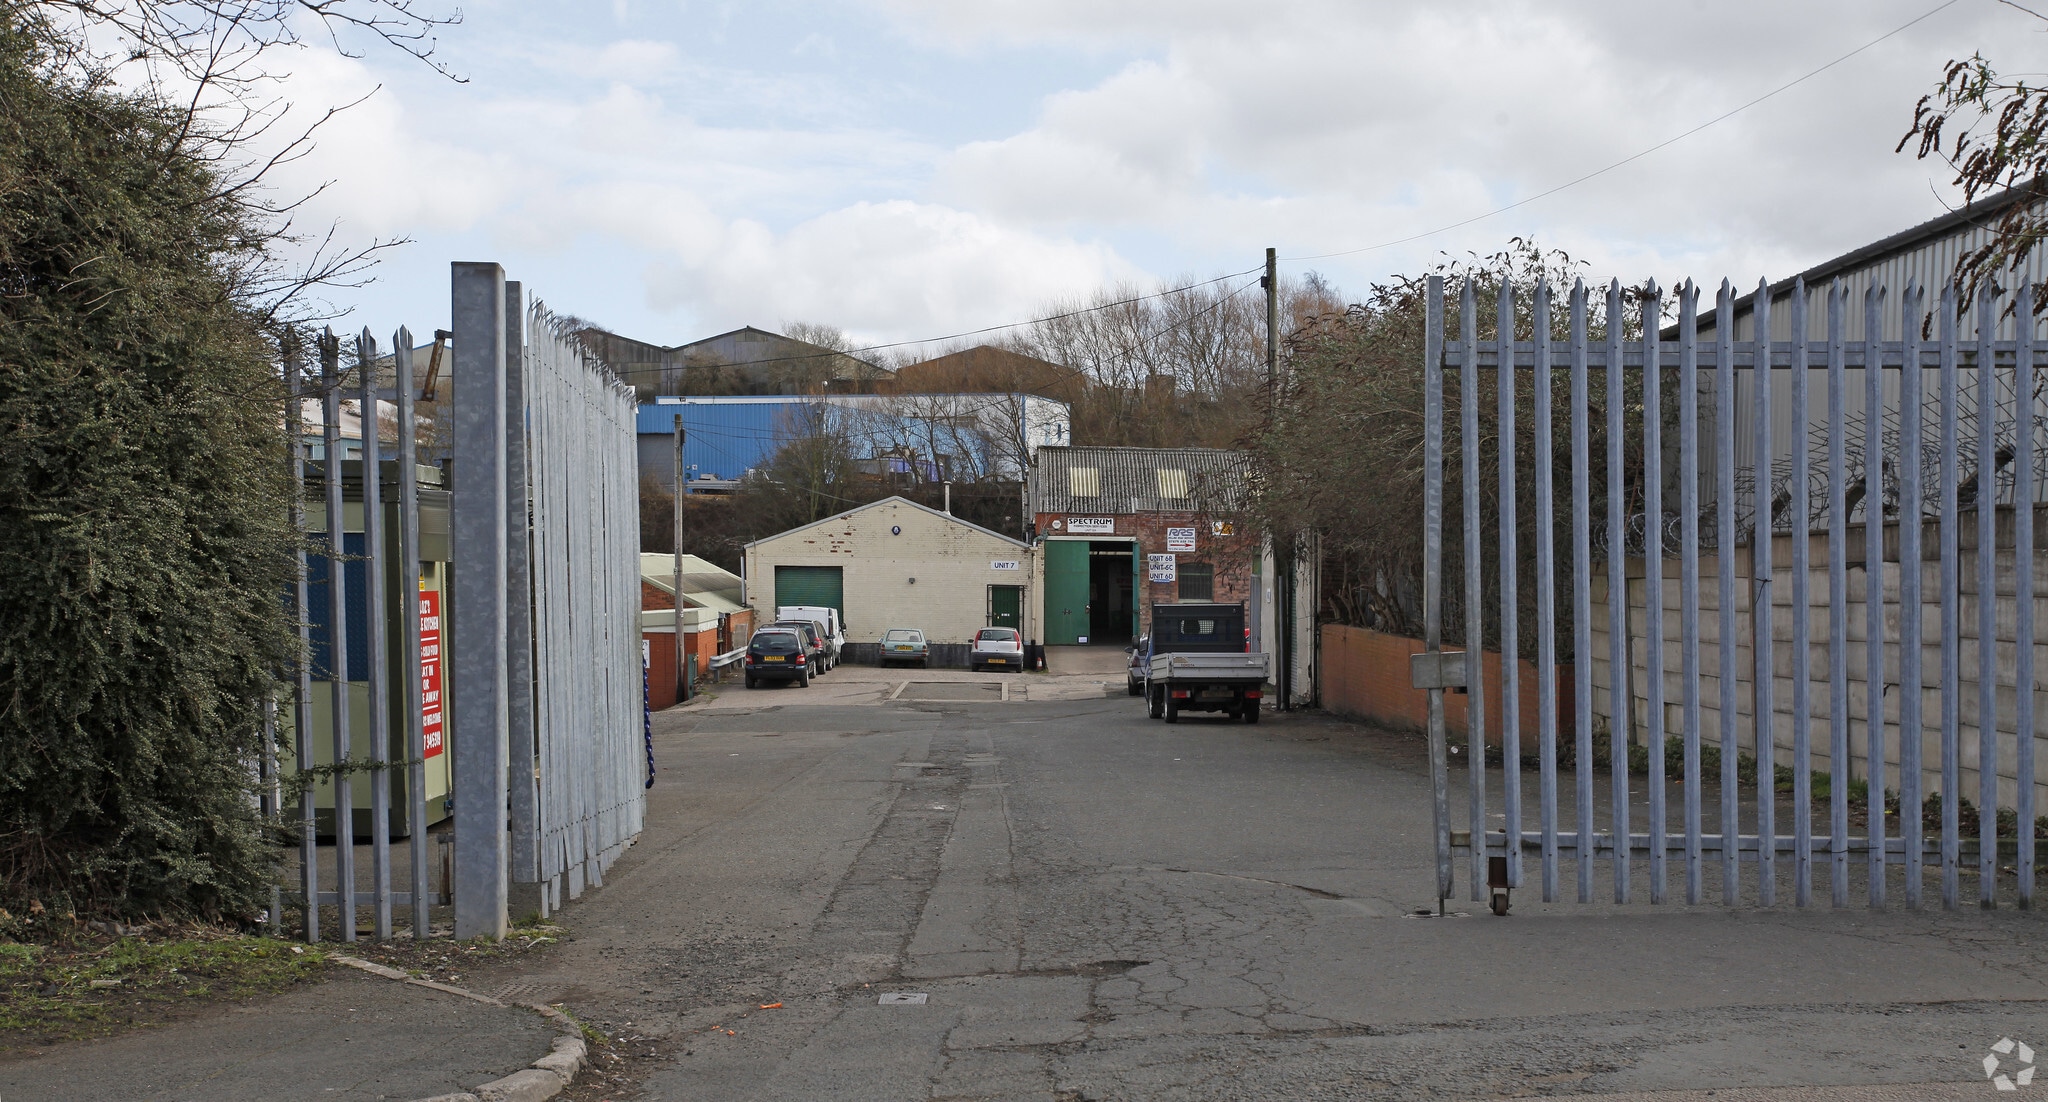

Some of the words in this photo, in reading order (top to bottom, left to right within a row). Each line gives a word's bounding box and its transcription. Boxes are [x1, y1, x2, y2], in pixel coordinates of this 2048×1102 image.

[1168, 528, 1194, 536] RRS
[428, 664, 434, 676] IN
[423, 679, 430, 690] OR
[426, 690, 439, 704] AWAY
